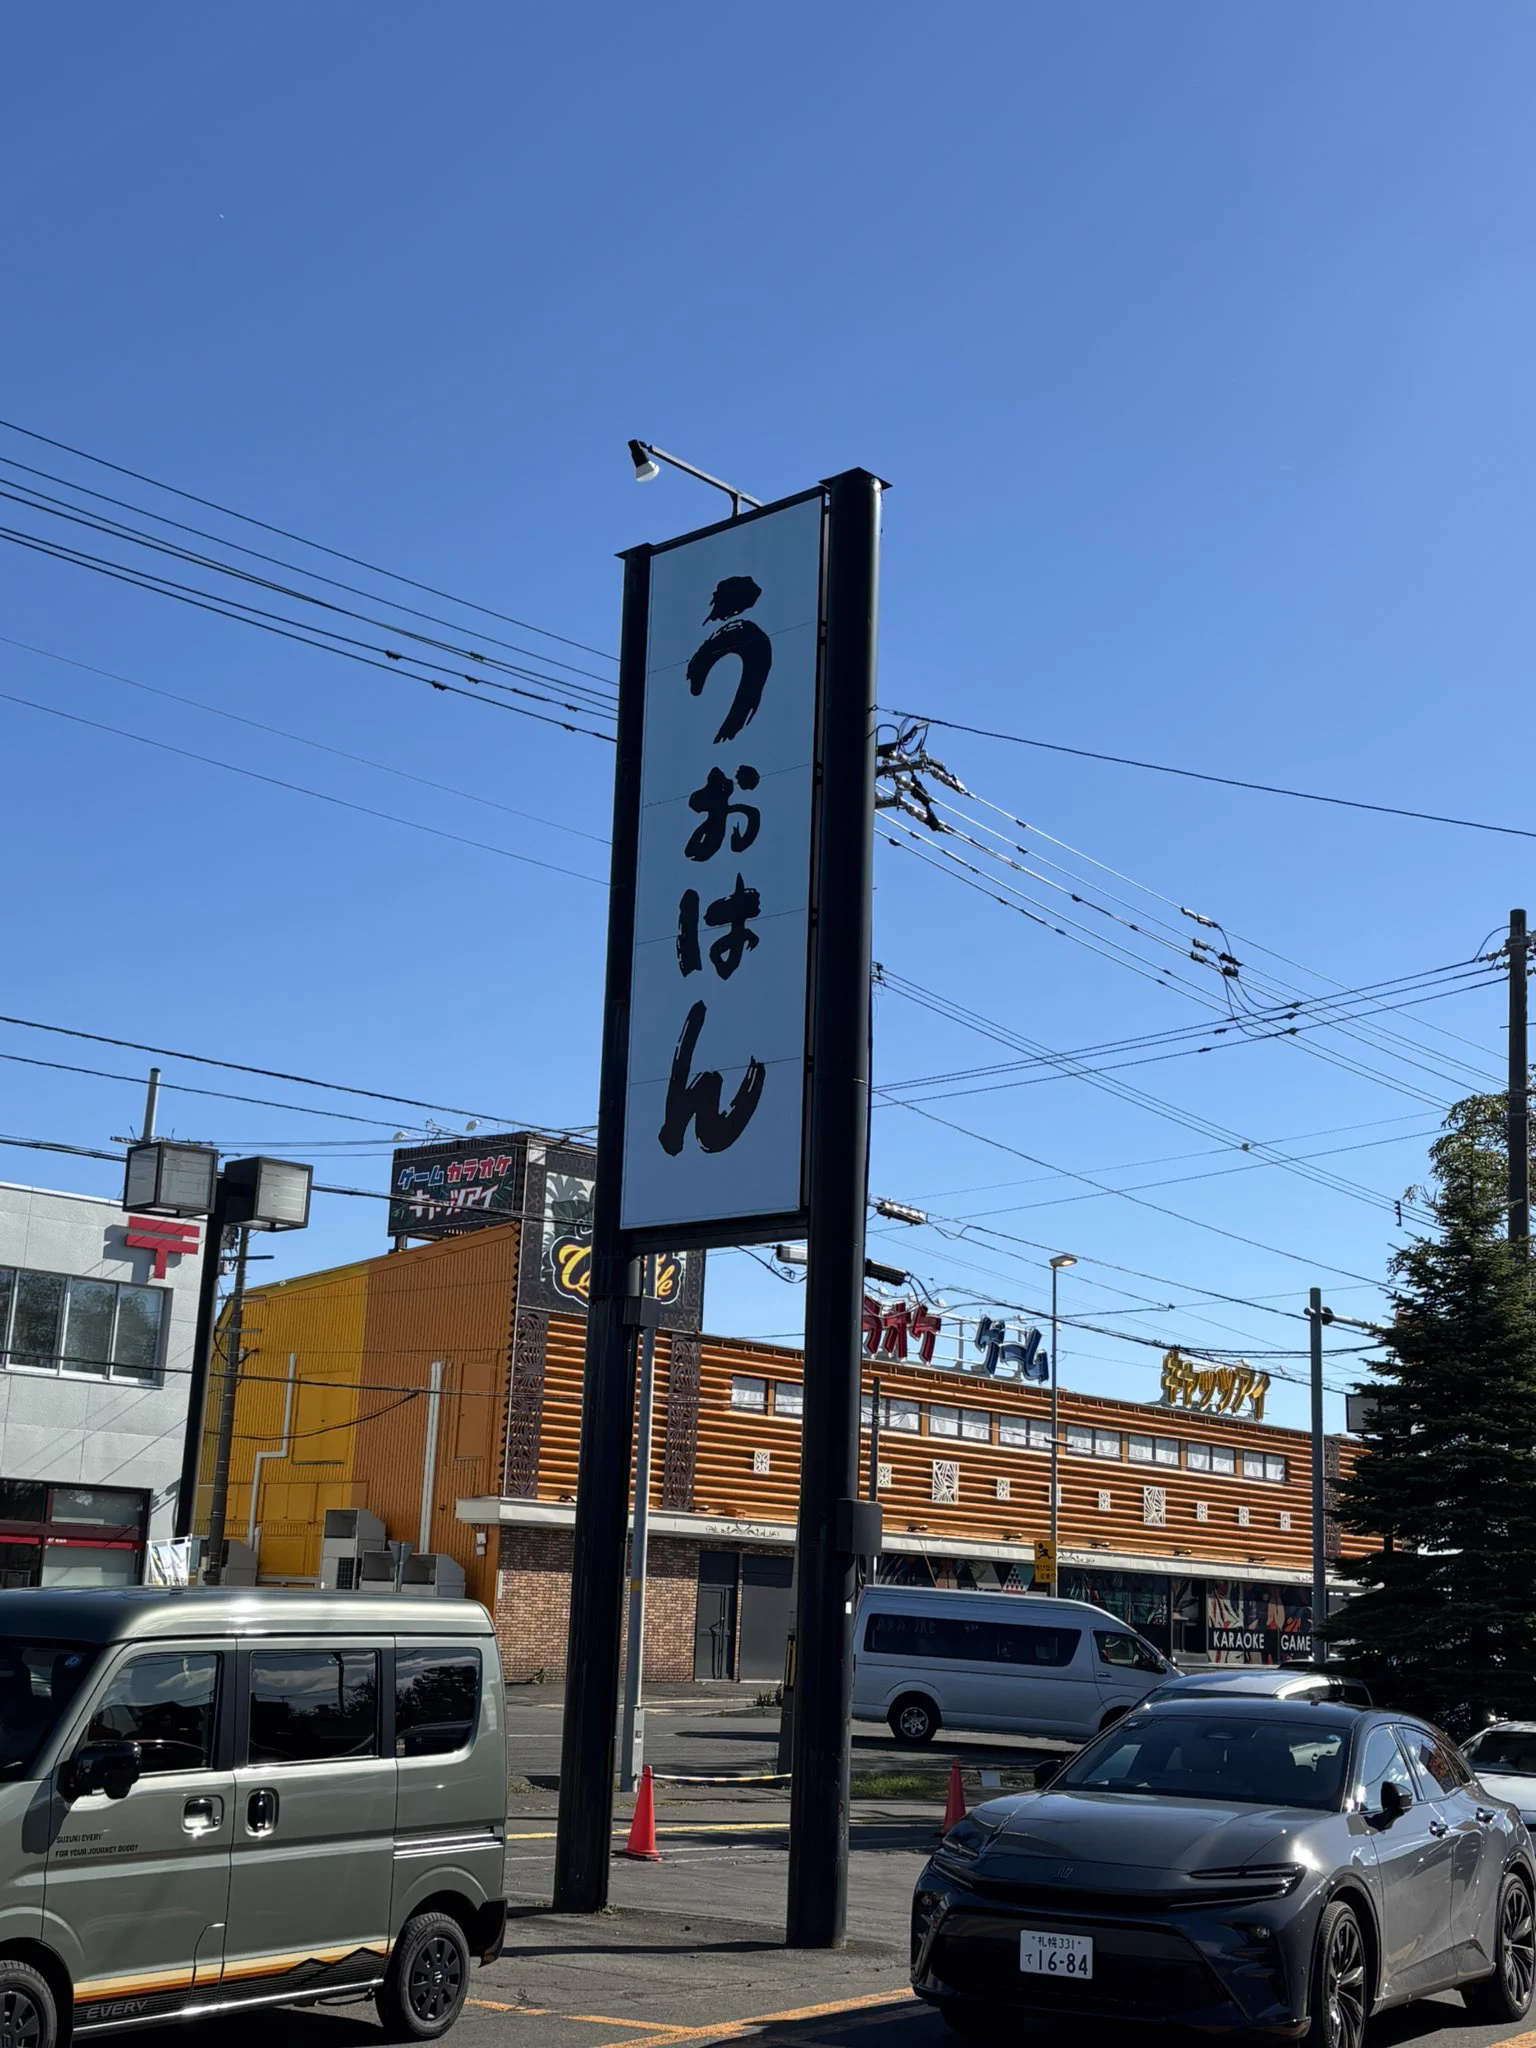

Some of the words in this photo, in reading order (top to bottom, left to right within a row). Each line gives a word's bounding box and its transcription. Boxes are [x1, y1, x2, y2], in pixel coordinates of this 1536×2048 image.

[659, 576, 772, 1156] うおはん
[398, 1165, 444, 1190] ゲーム
[447, 1155, 512, 1183] カラオケ
[1161, 1350, 1271, 1423] キャッツアイ
[1213, 1631, 1265, 1649] KARAOKE
[1280, 1634, 1311, 1651] GAME
[1024, 1953, 1033, 1965] て
[1039, 1949, 1088, 1976] 16-84
[86, 2000, 148, 2019] EVERY
